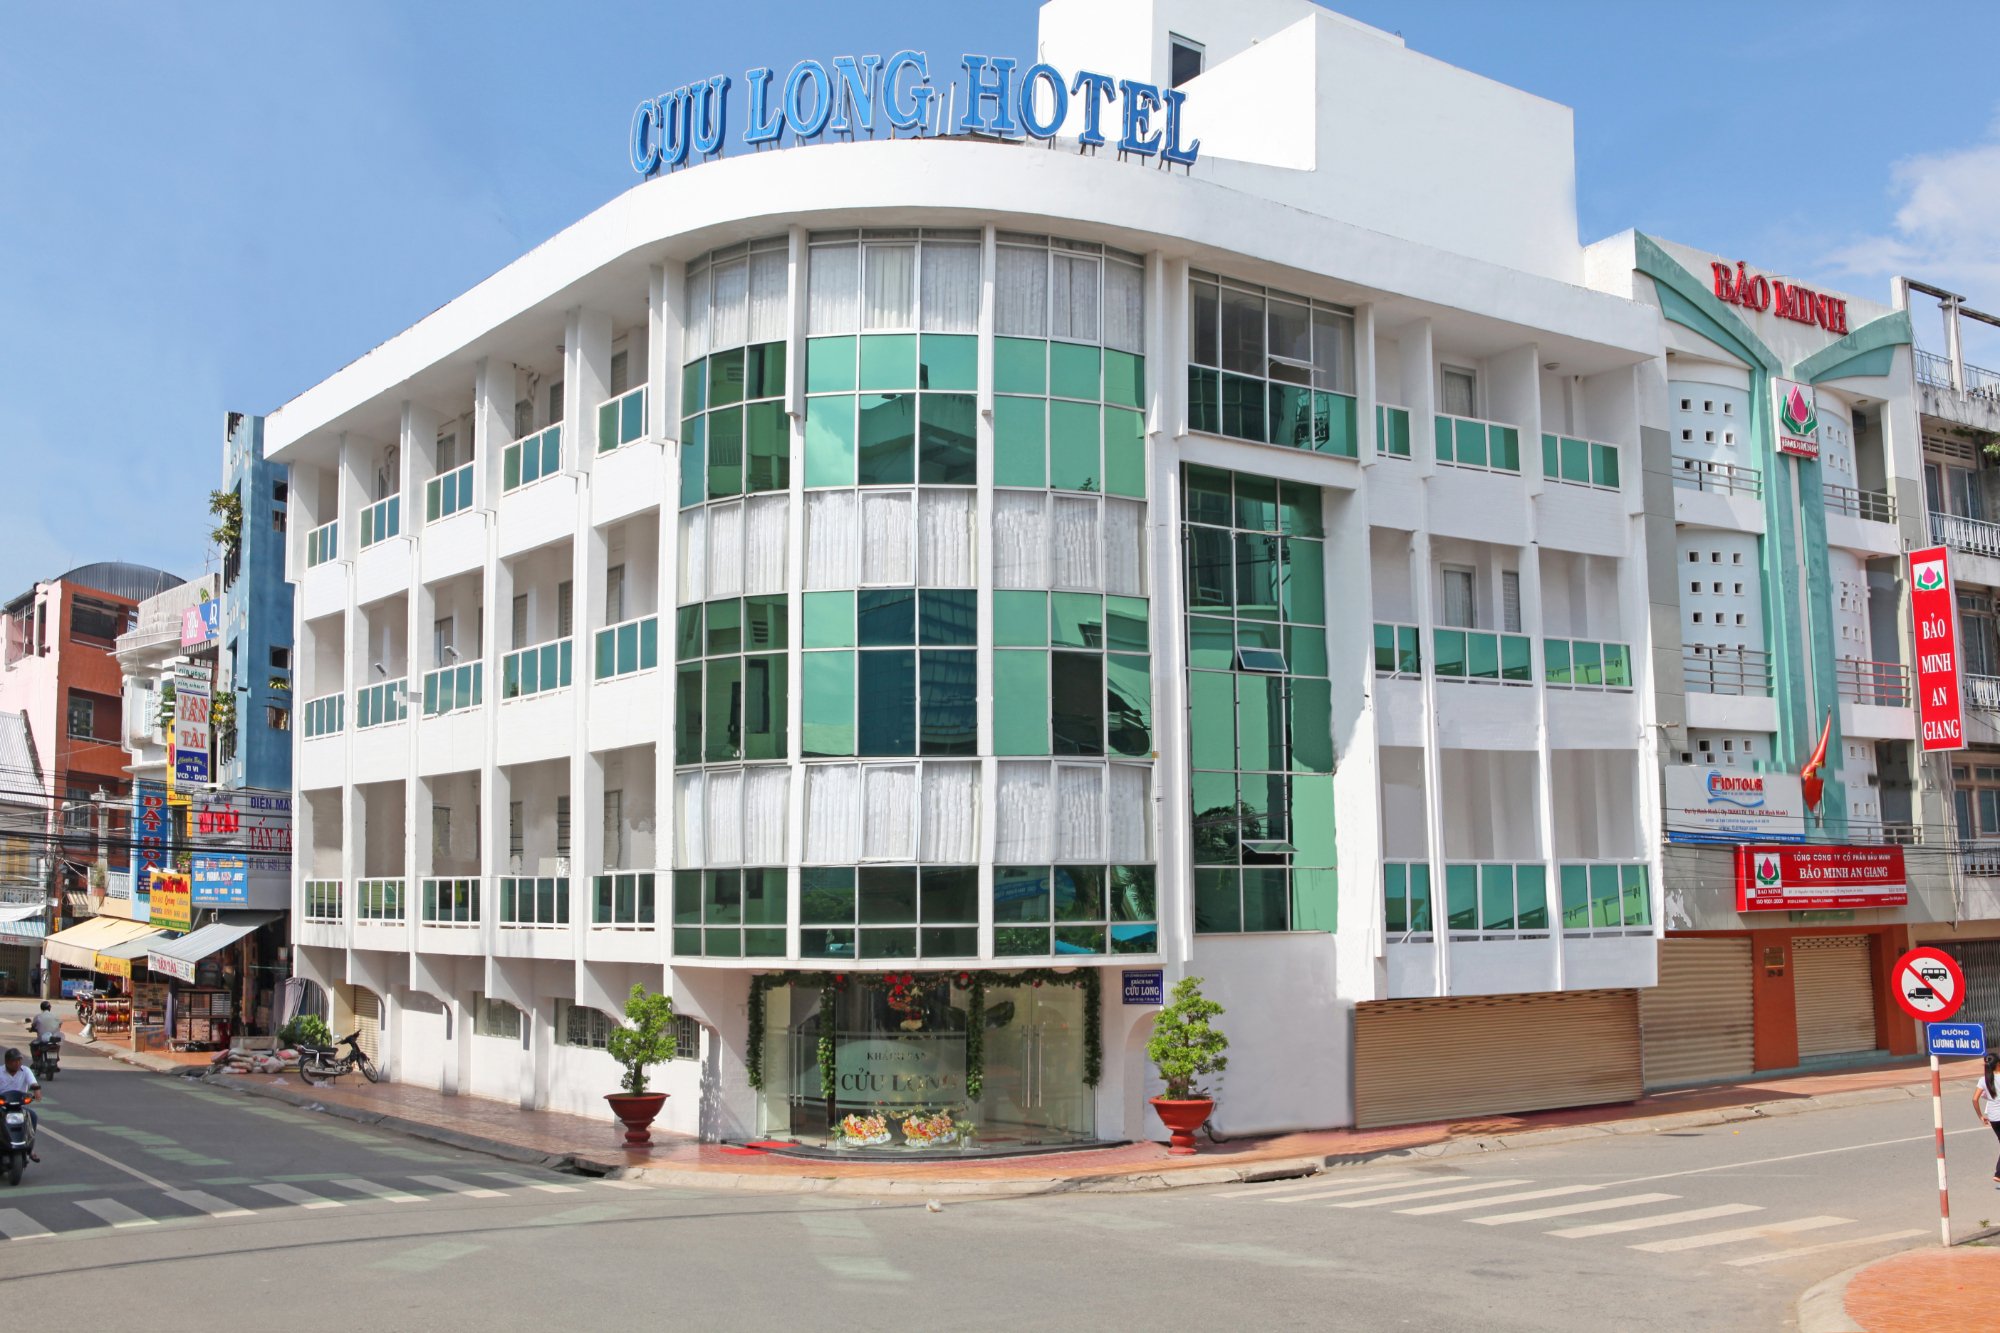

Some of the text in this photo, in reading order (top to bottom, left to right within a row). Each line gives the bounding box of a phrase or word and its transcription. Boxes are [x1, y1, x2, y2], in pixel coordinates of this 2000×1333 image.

[630, 49, 1201, 175] CUU LONG HOTEL
[1711, 261, 1849, 335] BẢO MINH
[1922, 613, 1946, 640] BẢO
[1921, 653, 1952, 674] MINH
[1932, 687, 1947, 706] AN
[1923, 719, 1959, 740] GIANG
[1799, 864, 1888, 879] BẢO MINH AN GIANG
[1141, 986, 1159, 996] LONG
[841, 1067, 884, 1092] CỬU
